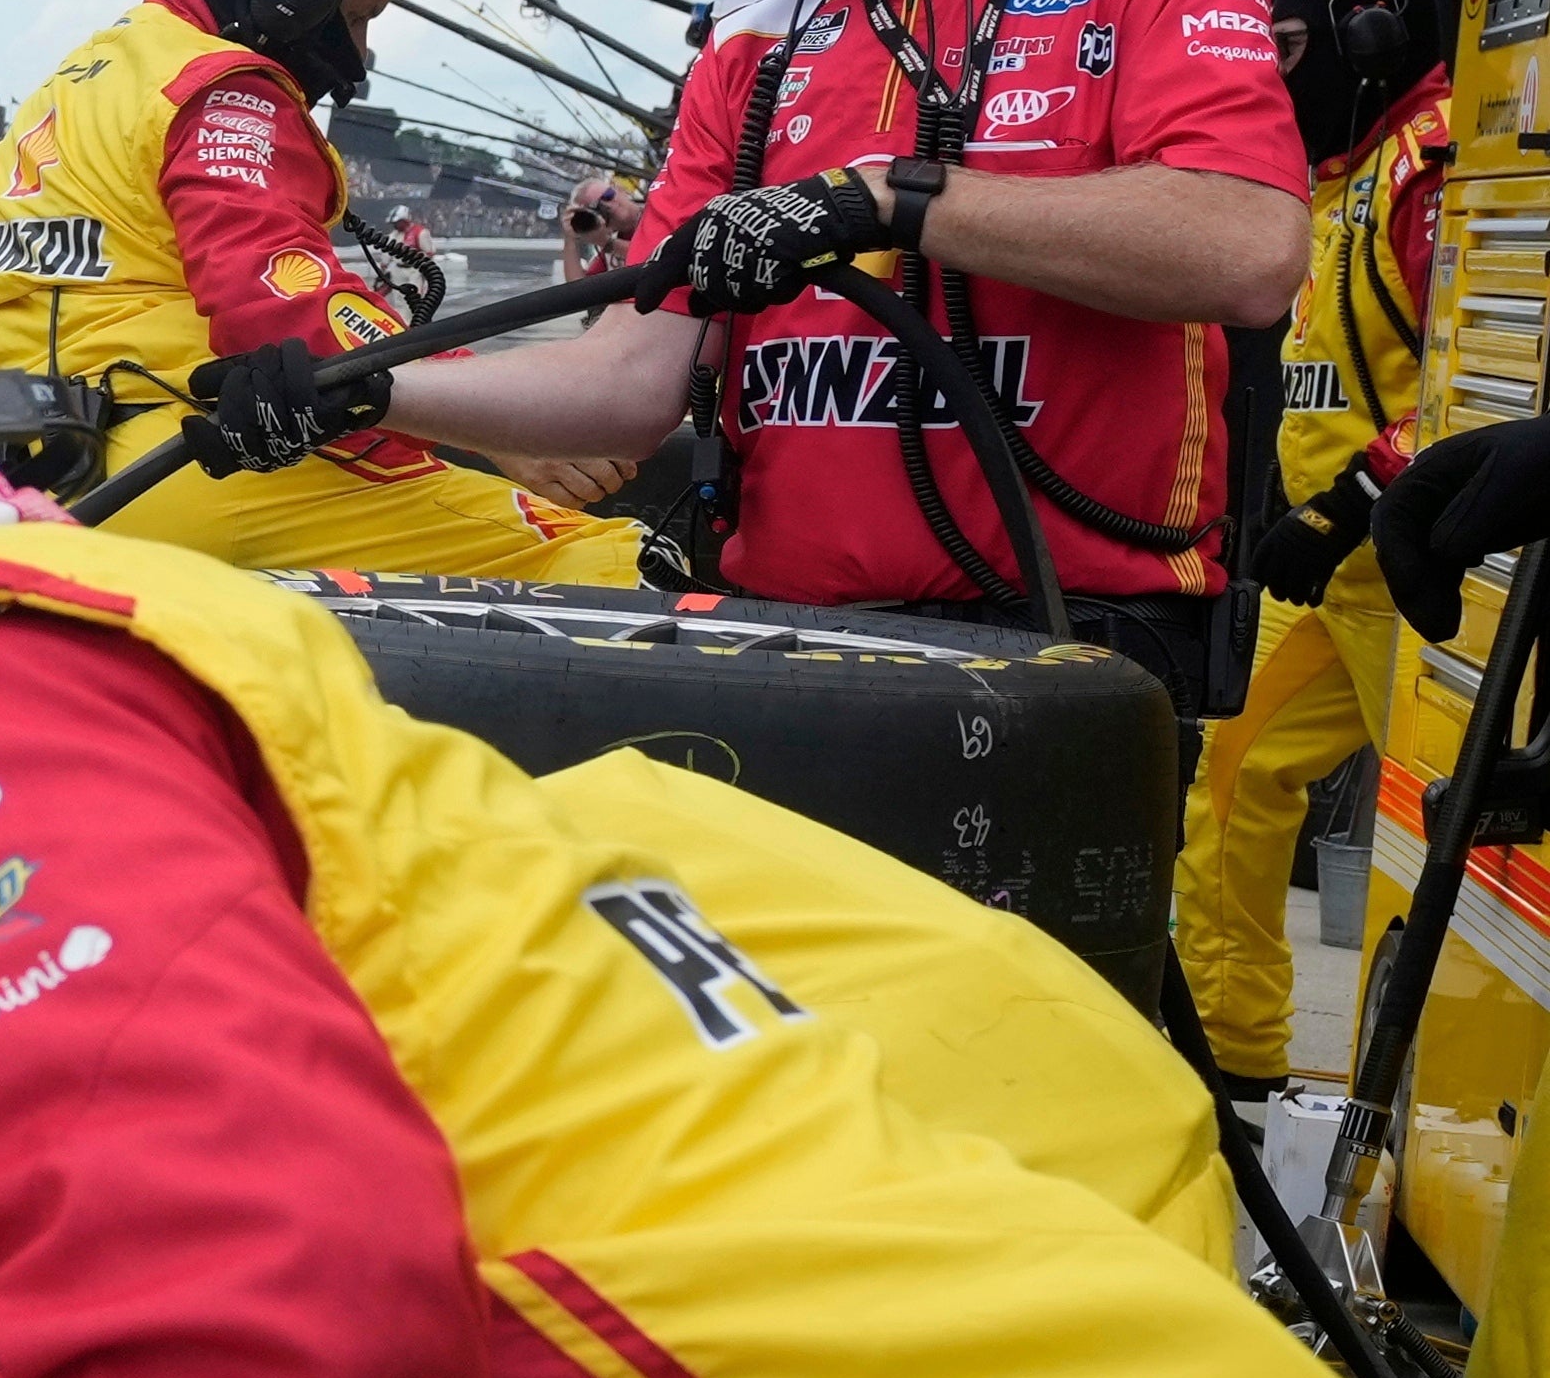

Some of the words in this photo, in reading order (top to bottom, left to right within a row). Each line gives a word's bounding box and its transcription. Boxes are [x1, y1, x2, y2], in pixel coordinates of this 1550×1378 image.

[984, 9, 1000, 39] TEAM
[802, 32, 831, 46] RIES
[943, 36, 1054, 67] DOUNT
[993, 57, 1017, 70] RE
[1187, 41, 1276, 65] Capgemin
[969, 69, 981, 102] TEAM
[206, 90, 276, 115] FORD
[992, 99, 1044, 120] AAA
[198, 128, 275, 160] Mazak
[334, 304, 391, 344] PENN
